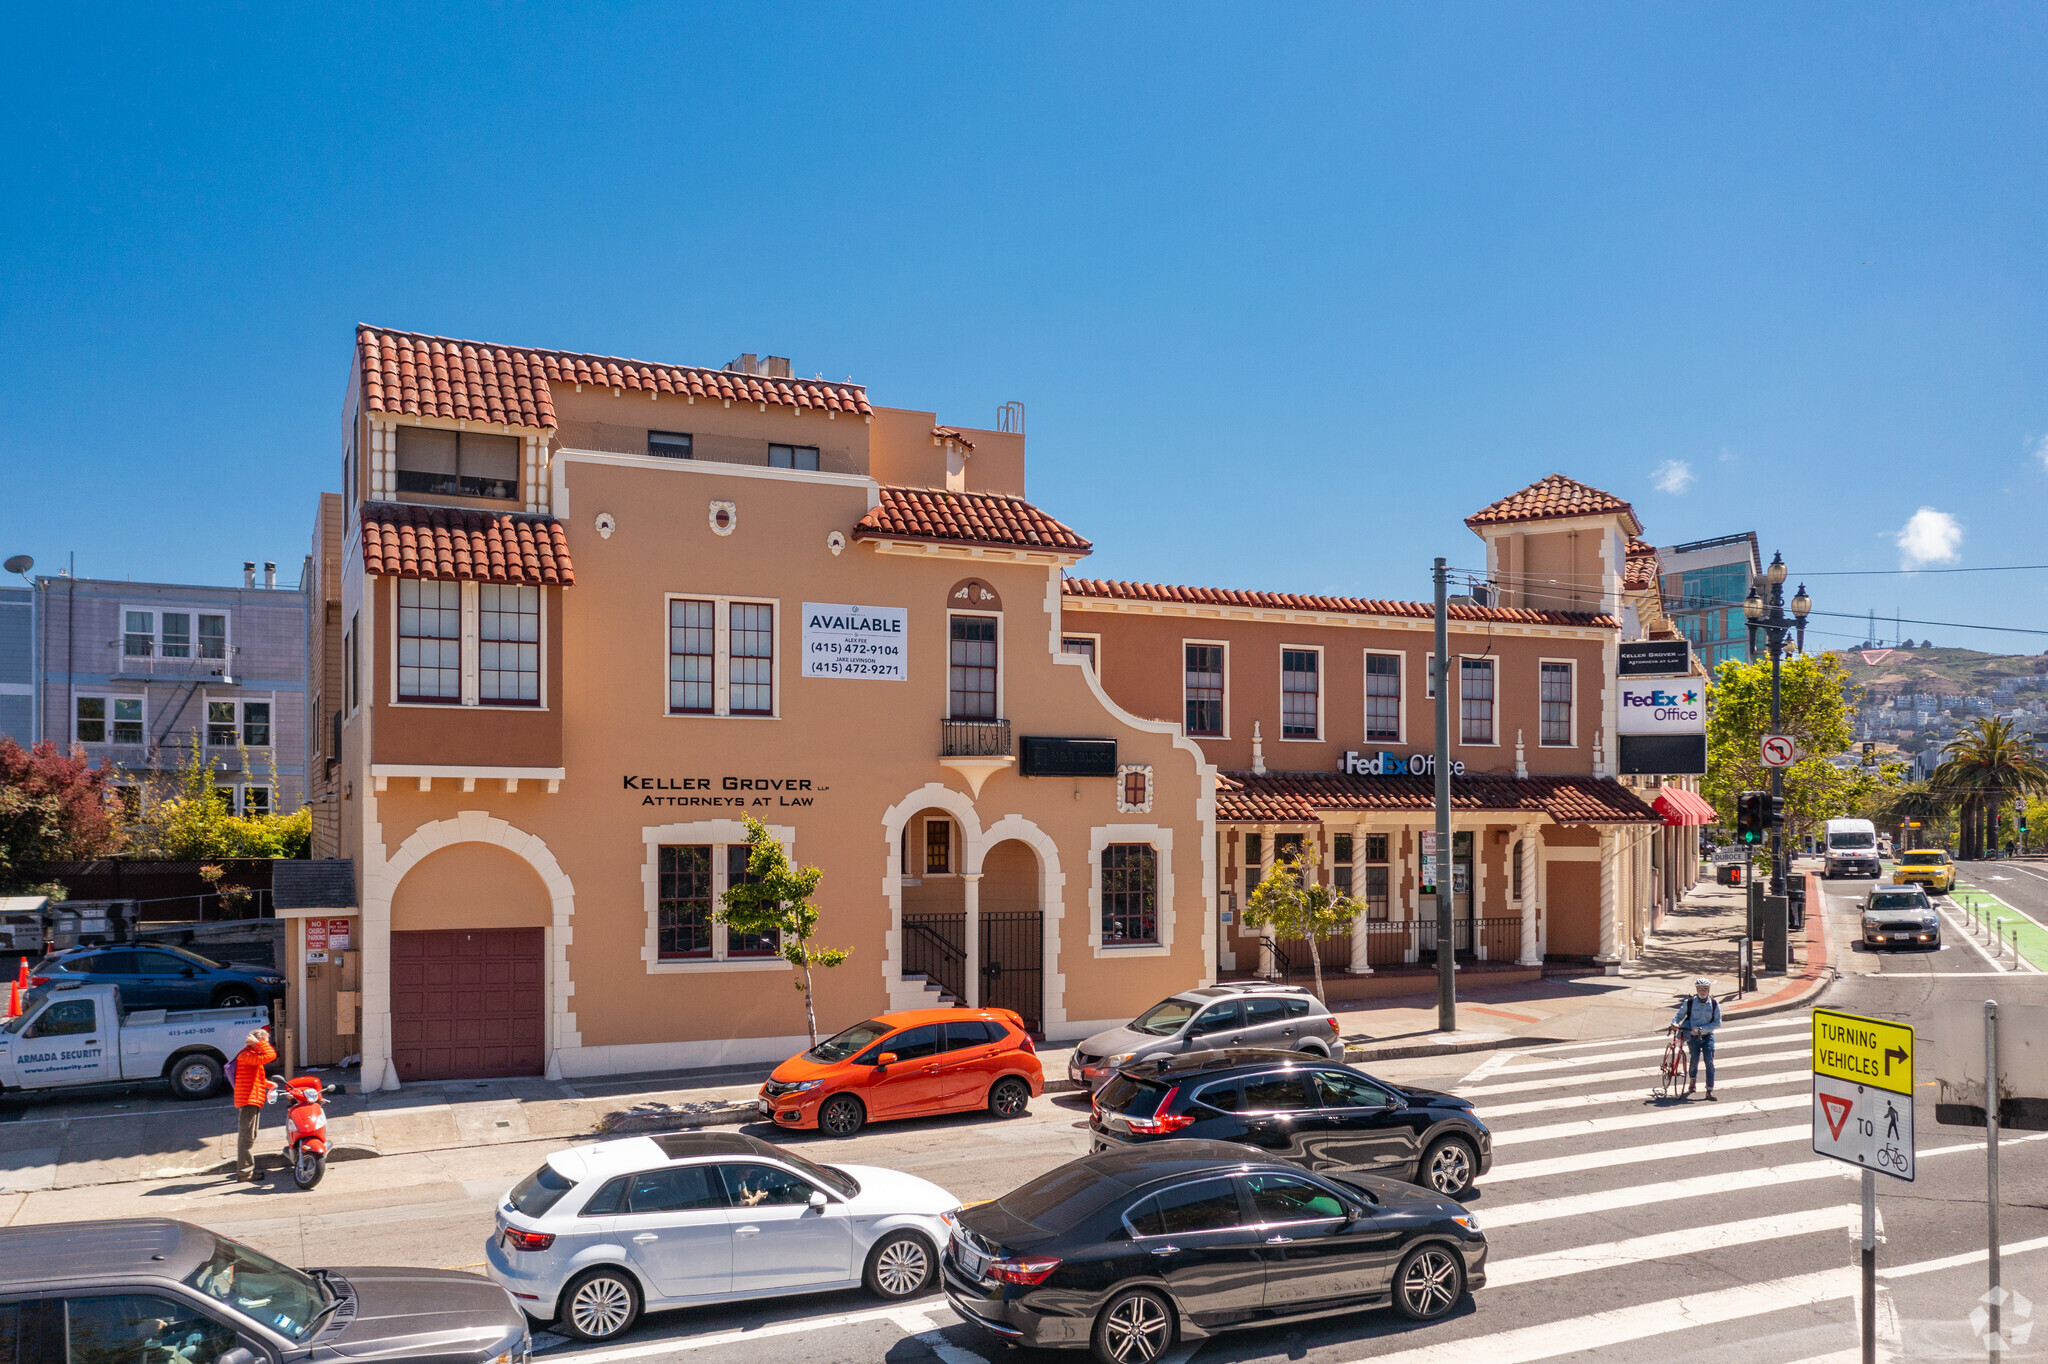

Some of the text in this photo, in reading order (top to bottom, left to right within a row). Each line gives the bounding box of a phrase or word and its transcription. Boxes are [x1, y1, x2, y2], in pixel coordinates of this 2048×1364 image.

[809, 615, 902, 632] AVAILABLE
[811, 642, 899, 655] (415) 472-9104
[811, 662, 899, 675] (415) 472-9271
[1623, 690, 1678, 707] FedEx
[1654, 707, 1698, 721] Office
[1345, 751, 1408, 775] FedEx
[623, 775, 711, 790] KELLER
[722, 776, 812, 791] GROVER
[642, 795, 814, 806] ATTORNEYS AT LAW
[1714, 853, 1742, 861] DUBOCE
[168, 1027, 216, 1036] 415-647-8500
[1821, 1023, 1877, 1050] TURNING
[16, 1048, 103, 1065] ARMADA SECURITY
[1819, 1048, 1879, 1077] VEHICLES
[24, 1062, 99, 1074] www.sfsecurity.com
[1830, 1105, 1842, 1114] YIELD
[1857, 1117, 1874, 1137] TO
